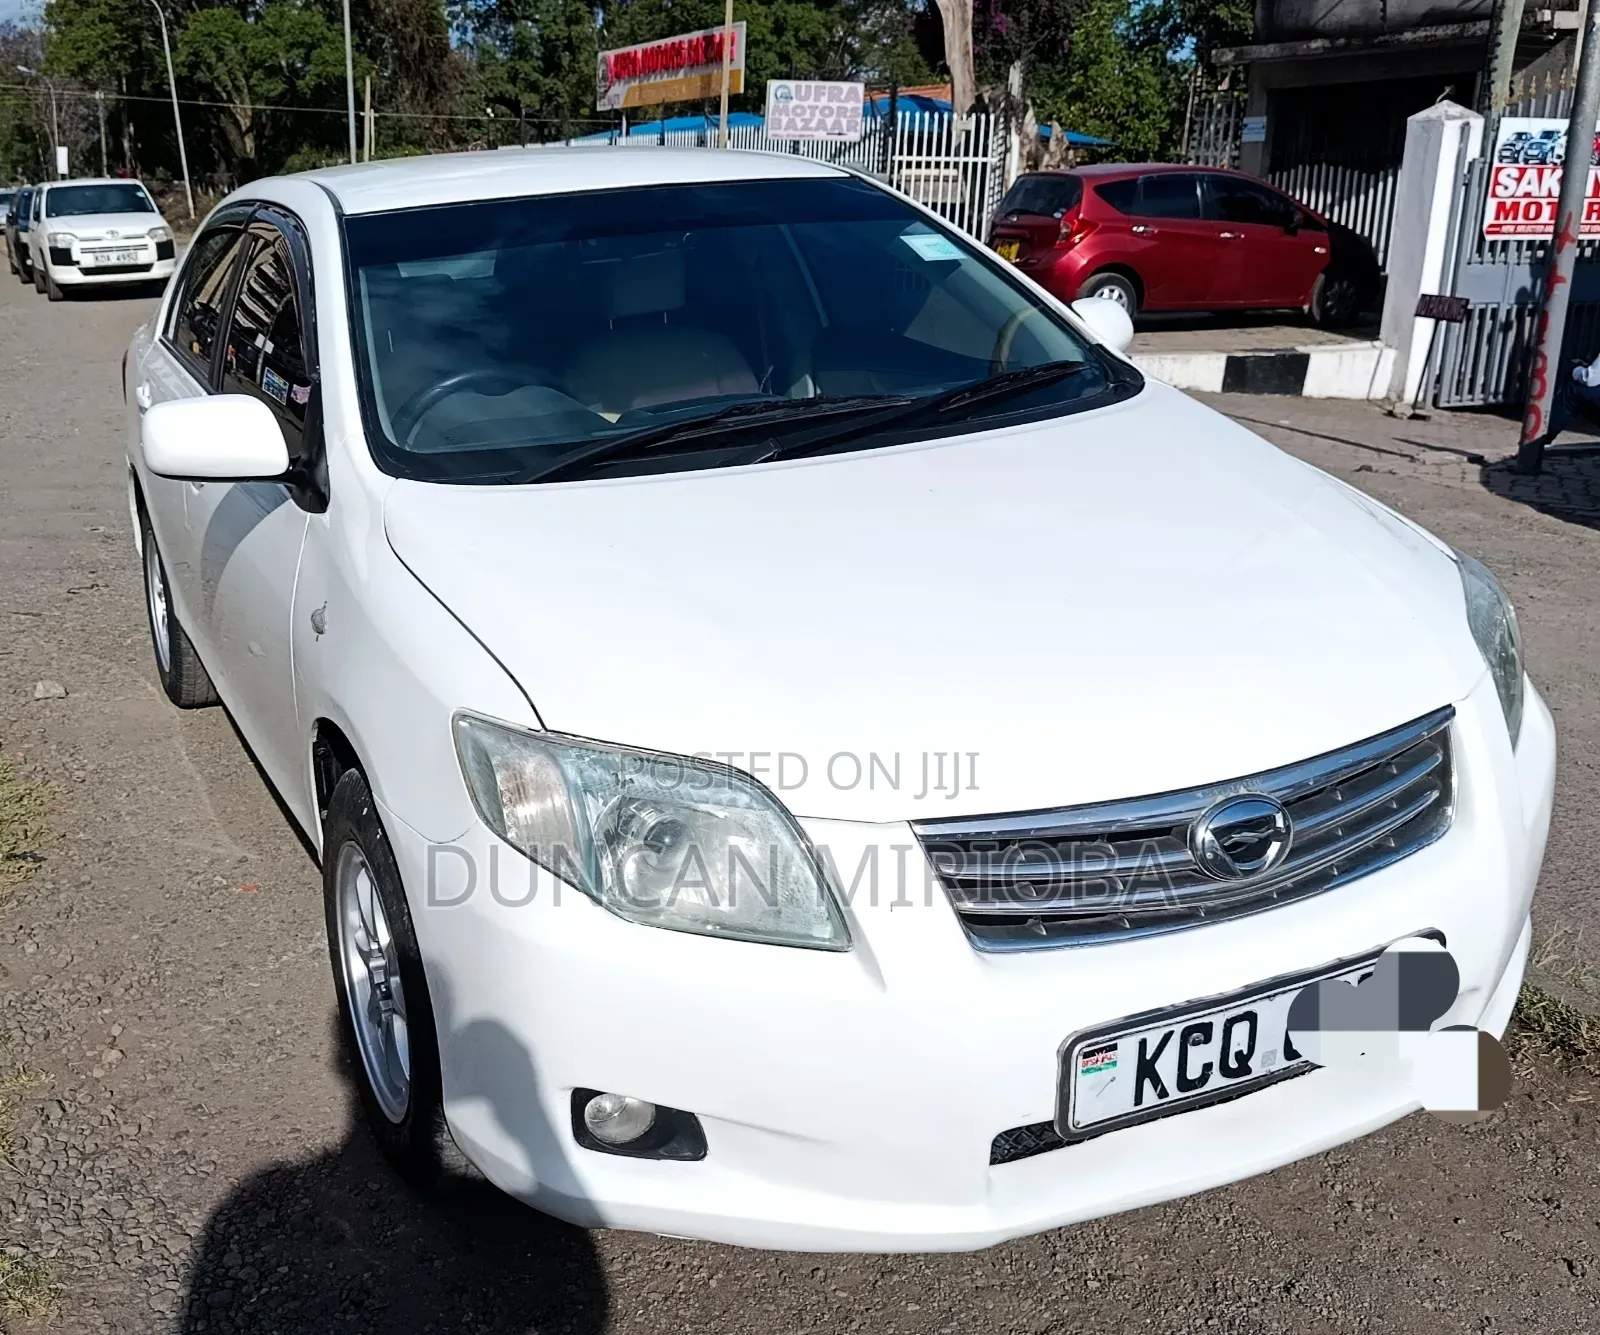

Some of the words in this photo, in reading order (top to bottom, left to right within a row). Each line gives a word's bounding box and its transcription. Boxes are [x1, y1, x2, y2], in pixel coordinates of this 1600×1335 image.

[795, 84, 861, 103] UFRA
[771, 104, 861, 119] MOTORS
[770, 118, 859, 133] BAZAAR
[1133, 1008, 1258, 1107] KCQ
